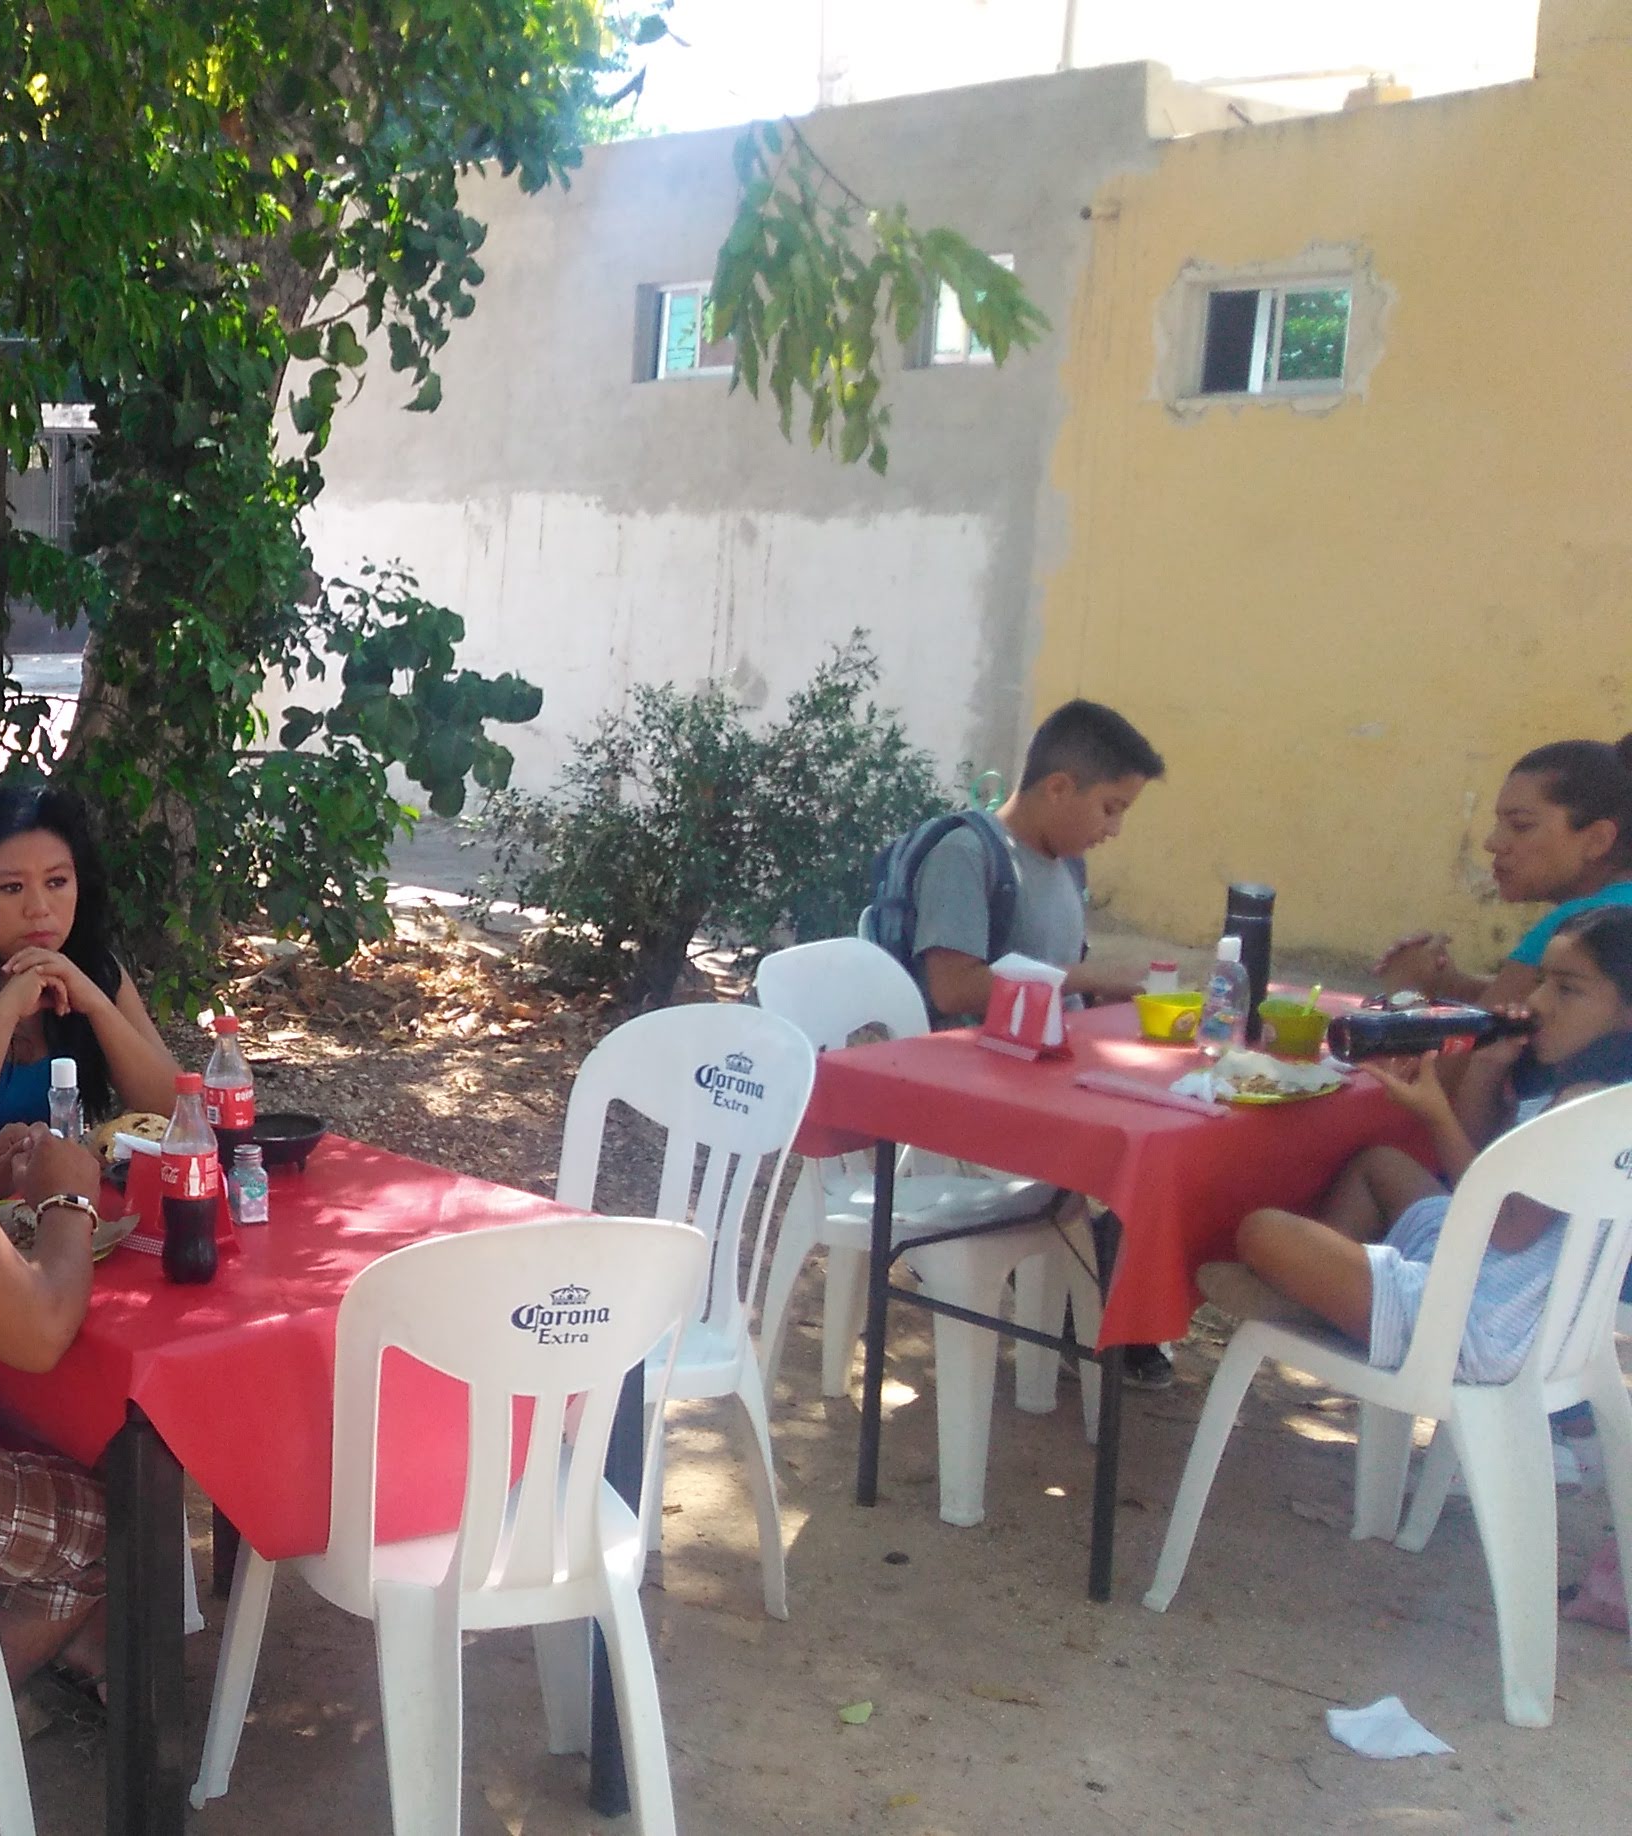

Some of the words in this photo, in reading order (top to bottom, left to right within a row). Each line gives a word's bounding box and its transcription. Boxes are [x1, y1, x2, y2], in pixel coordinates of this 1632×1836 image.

[694, 1063, 765, 1100] Corona
[713, 1089, 749, 1115] Extra
[510, 1303, 611, 1333] Corona
[537, 1327, 590, 1345] Extra
